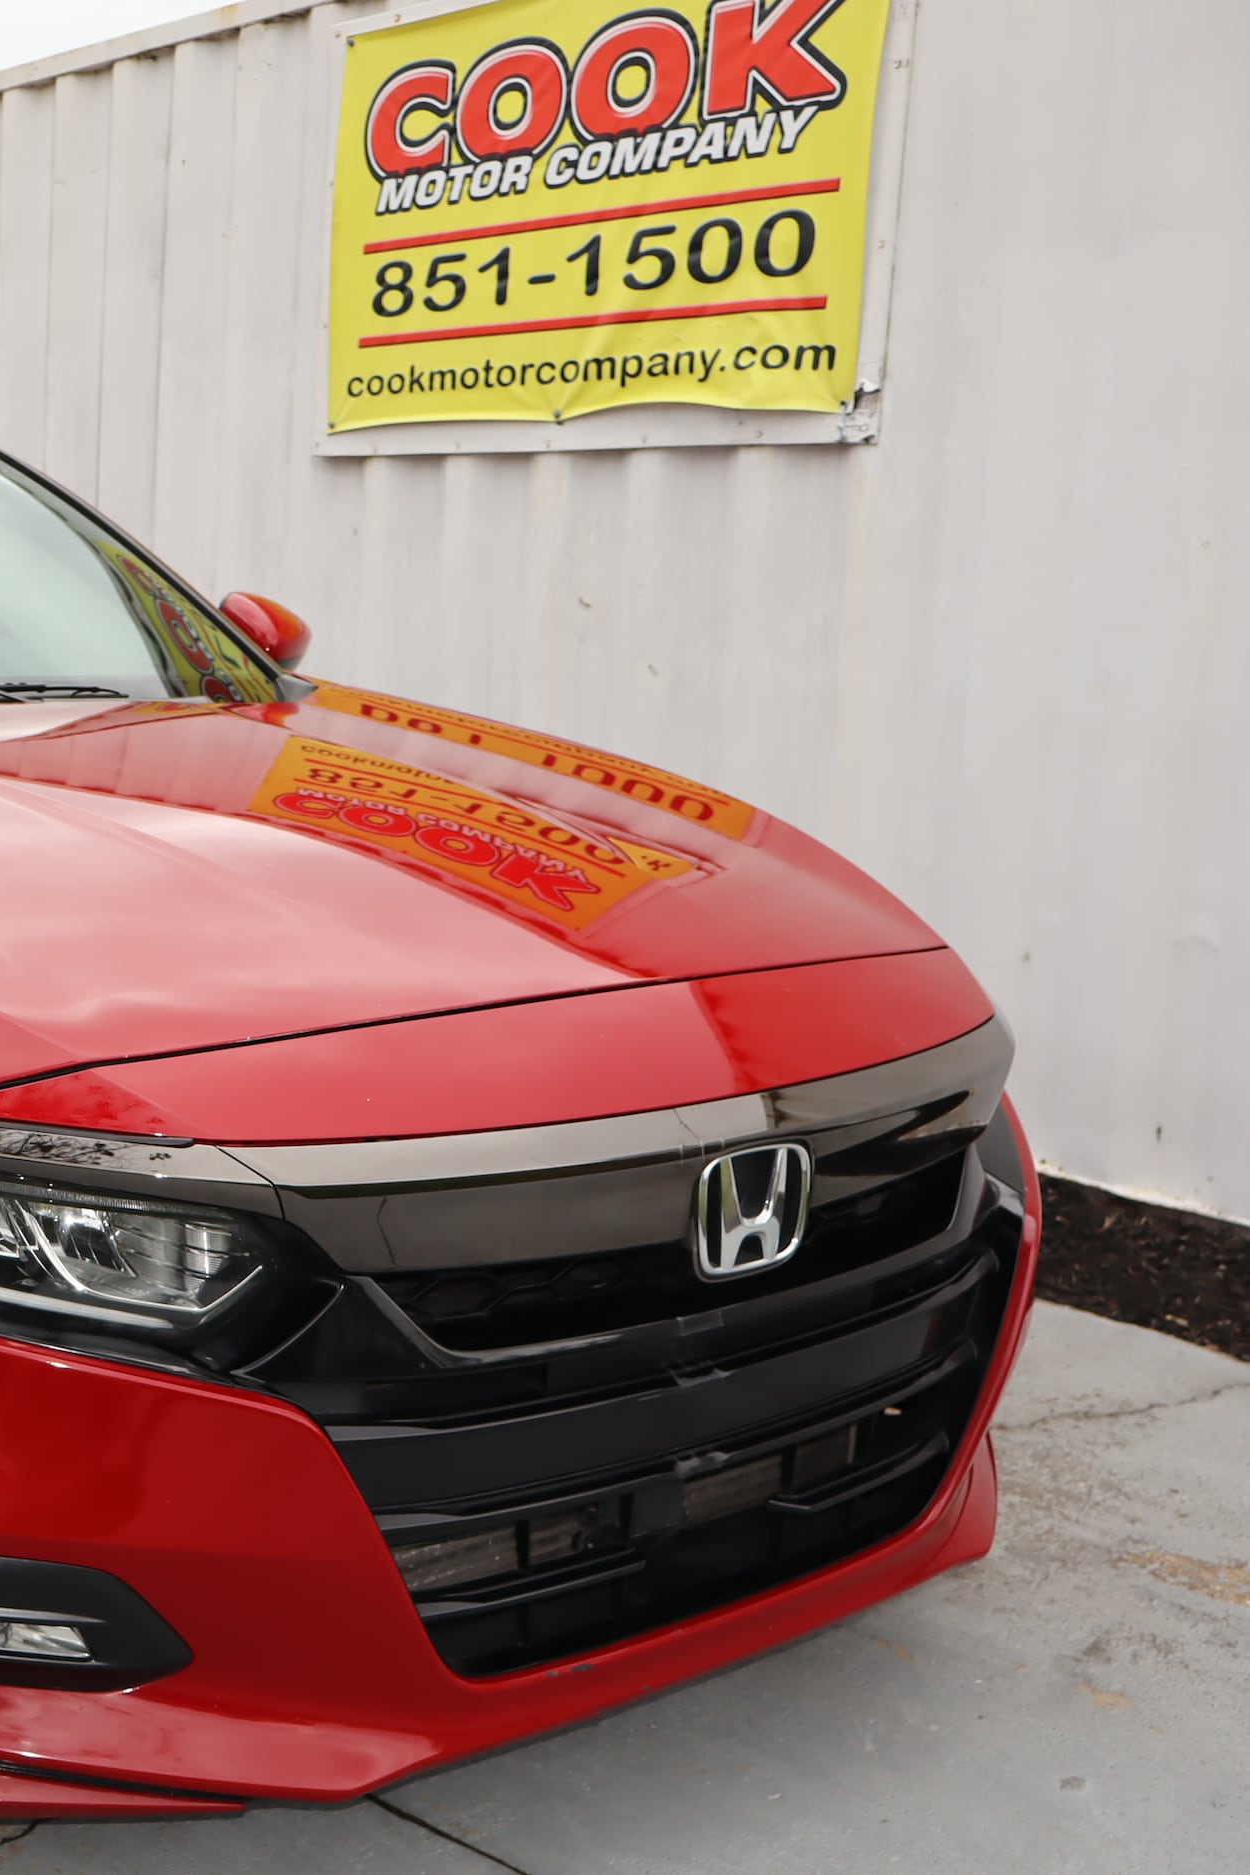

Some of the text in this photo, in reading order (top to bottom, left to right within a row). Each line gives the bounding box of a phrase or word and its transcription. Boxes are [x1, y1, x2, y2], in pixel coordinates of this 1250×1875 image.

[367, 0, 846, 178] COOK
[375, 104, 821, 215] MOTOR COMPANY
[371, 209, 817, 317] 851-1500
[347, 343, 836, 399] cookmotorcompany.com
